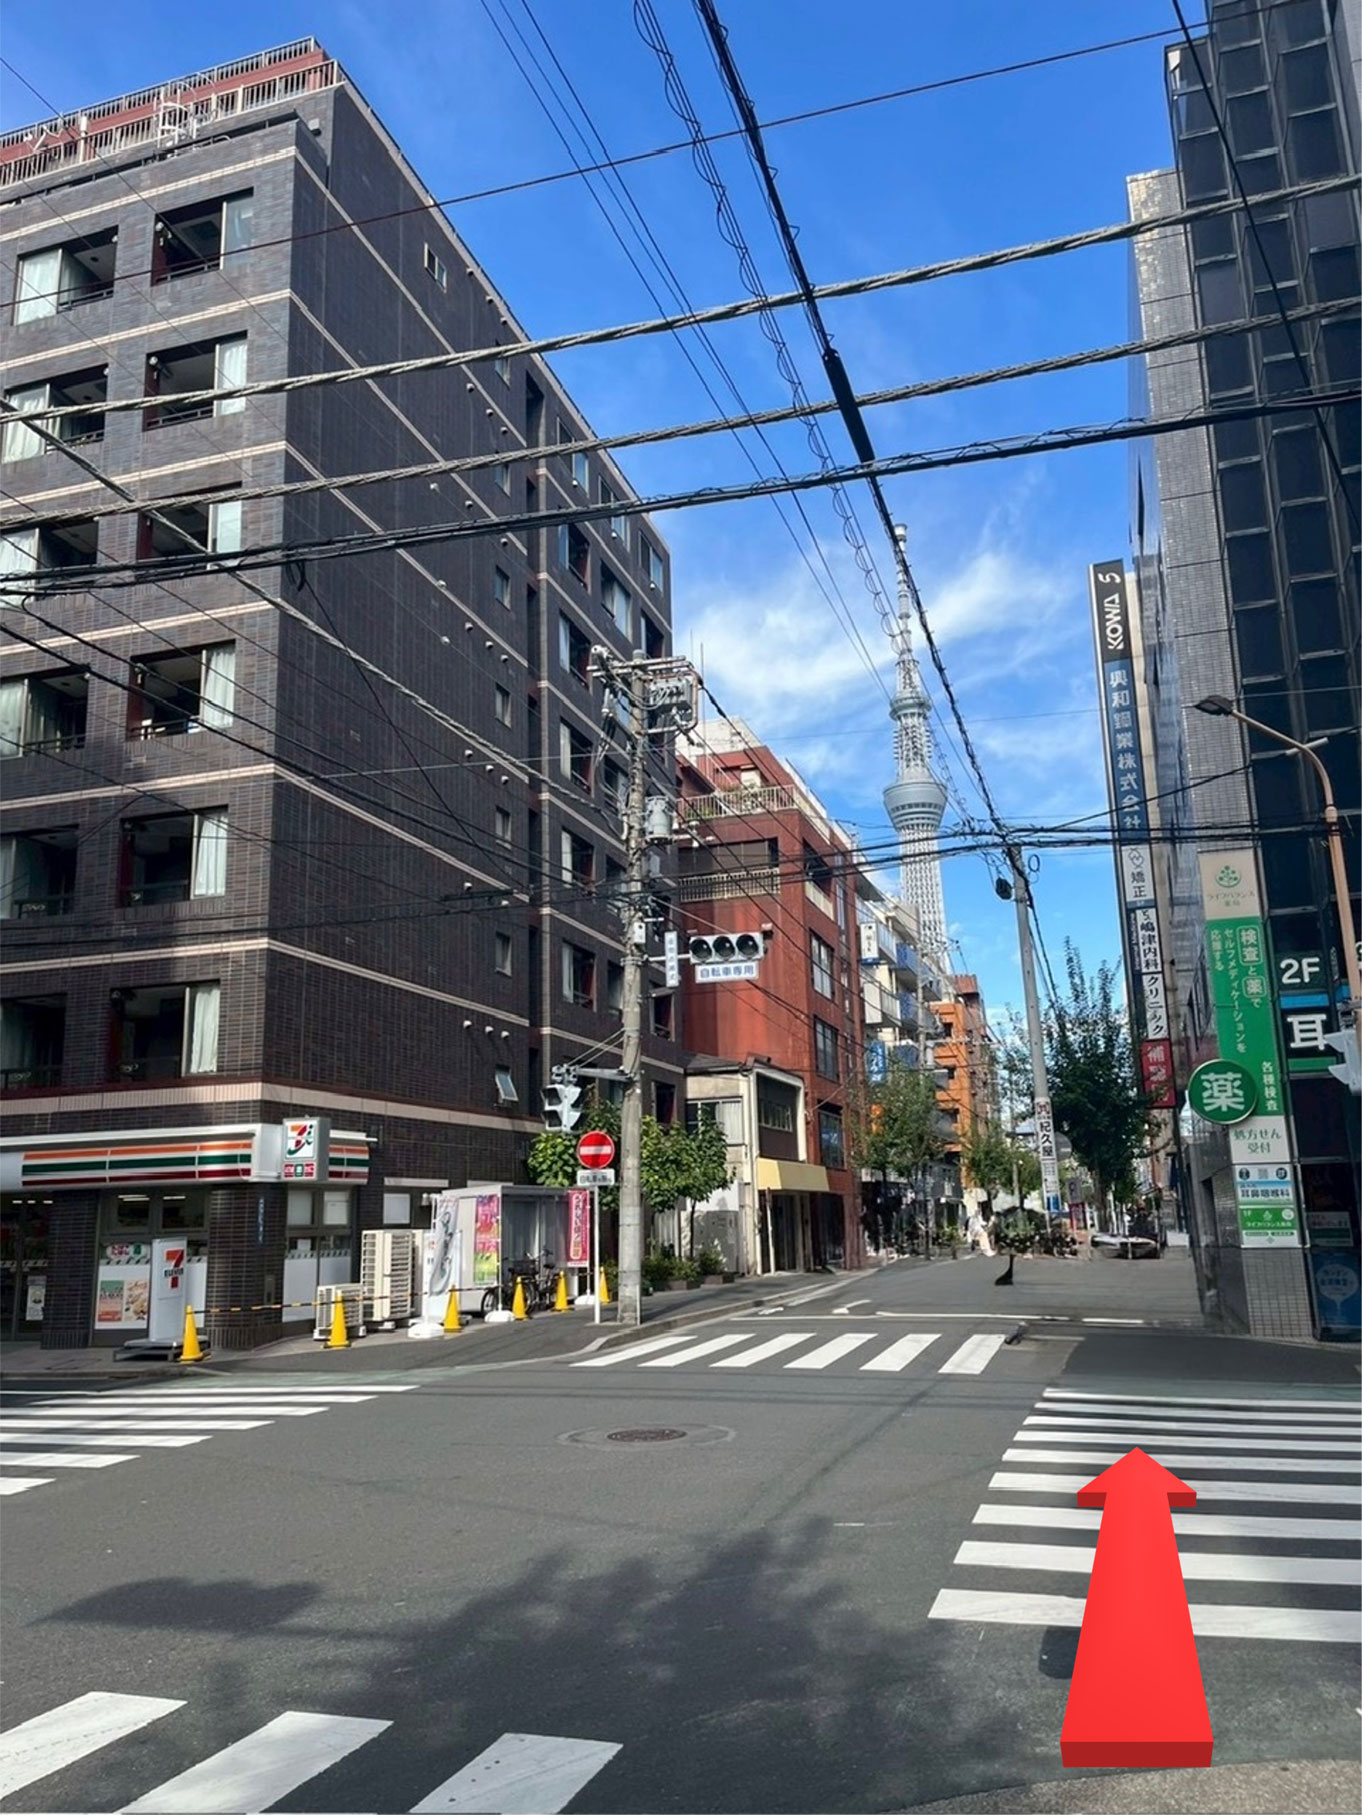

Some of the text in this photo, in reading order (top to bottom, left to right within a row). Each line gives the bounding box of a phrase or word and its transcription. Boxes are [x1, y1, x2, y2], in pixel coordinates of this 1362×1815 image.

[1104, 593, 1124, 649] KOWA
[700, 965, 754, 978] 自転車専用
[1280, 957, 1320, 984] 2F
[1286, 1013, 1328, 1051] 耳
[1200, 1071, 1245, 1112] 薬
[1233, 1128, 1282, 1140] 処方せん
[1247, 1142, 1271, 1154] 受付
